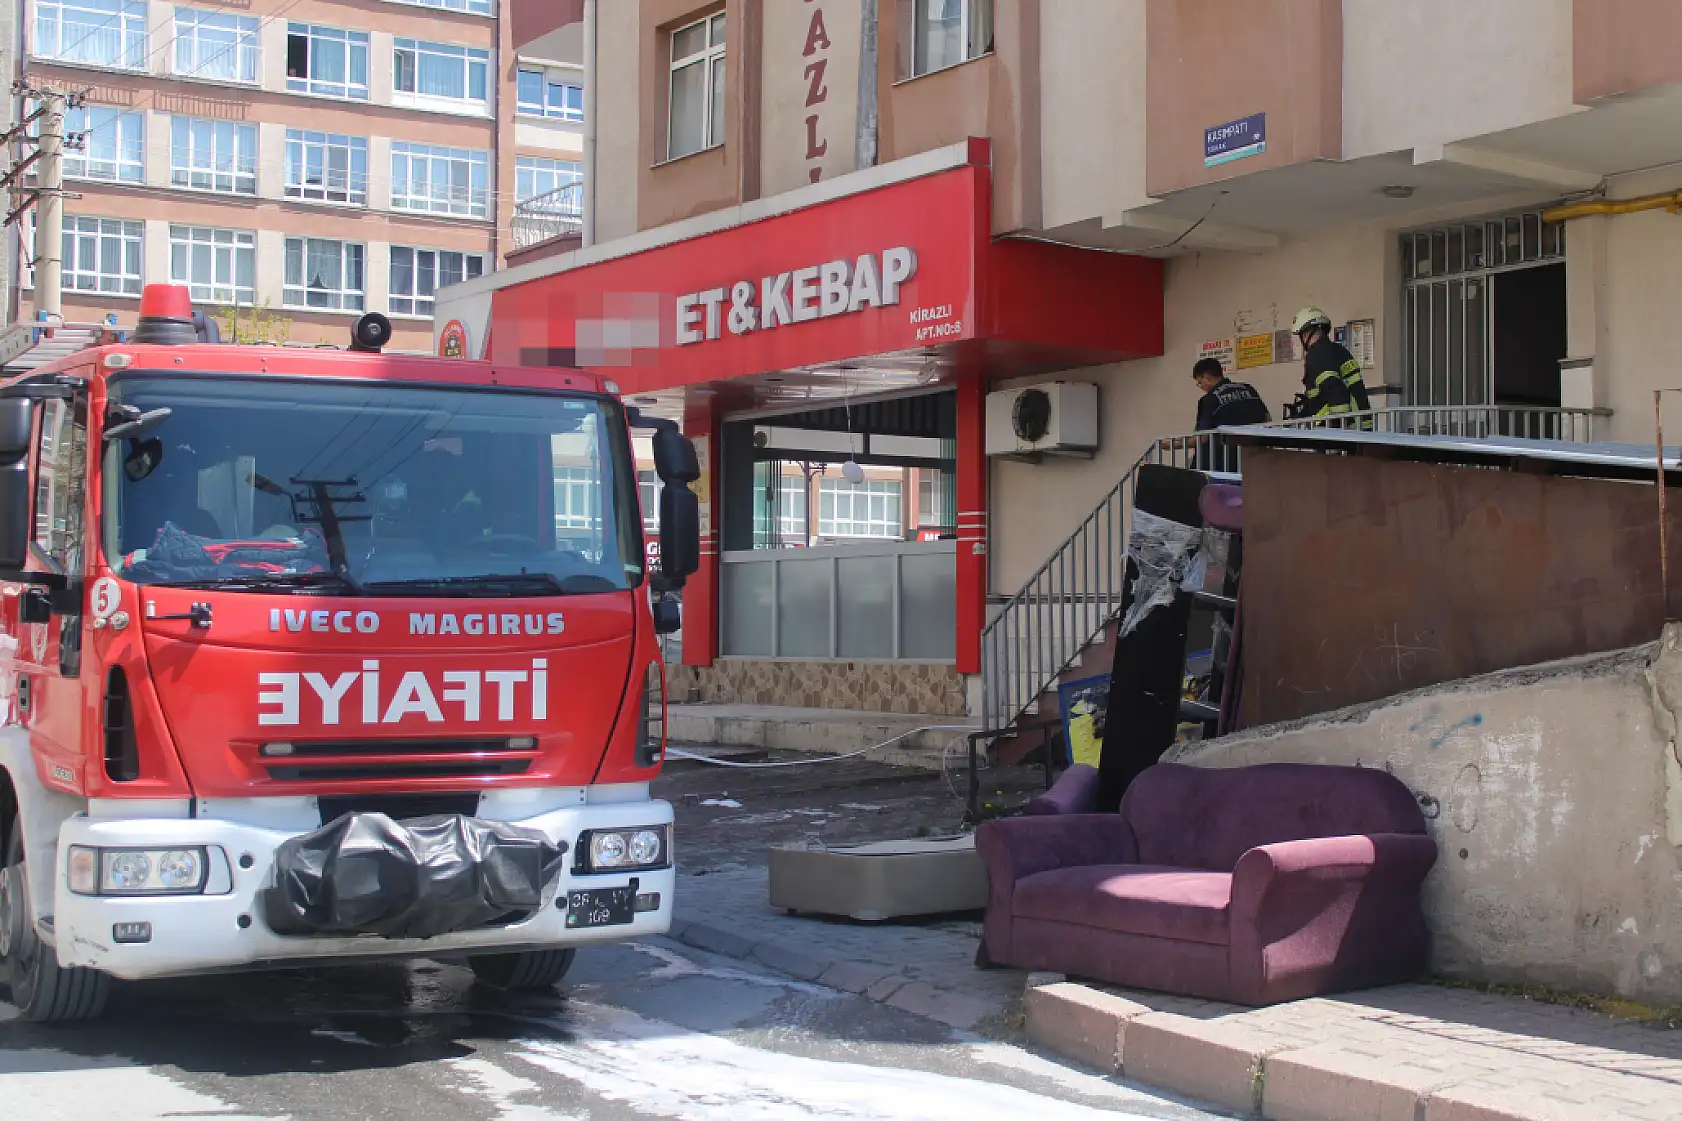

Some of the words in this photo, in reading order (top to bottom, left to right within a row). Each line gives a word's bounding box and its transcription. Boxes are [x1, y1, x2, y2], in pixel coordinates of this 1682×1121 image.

[676, 246, 918, 346] ET&KEBAP
[909, 303, 953, 325] KİRAZLI
[97, 584, 109, 612] 5
[269, 608, 380, 633] IVECO
[409, 612, 565, 635] MAGIRUS
